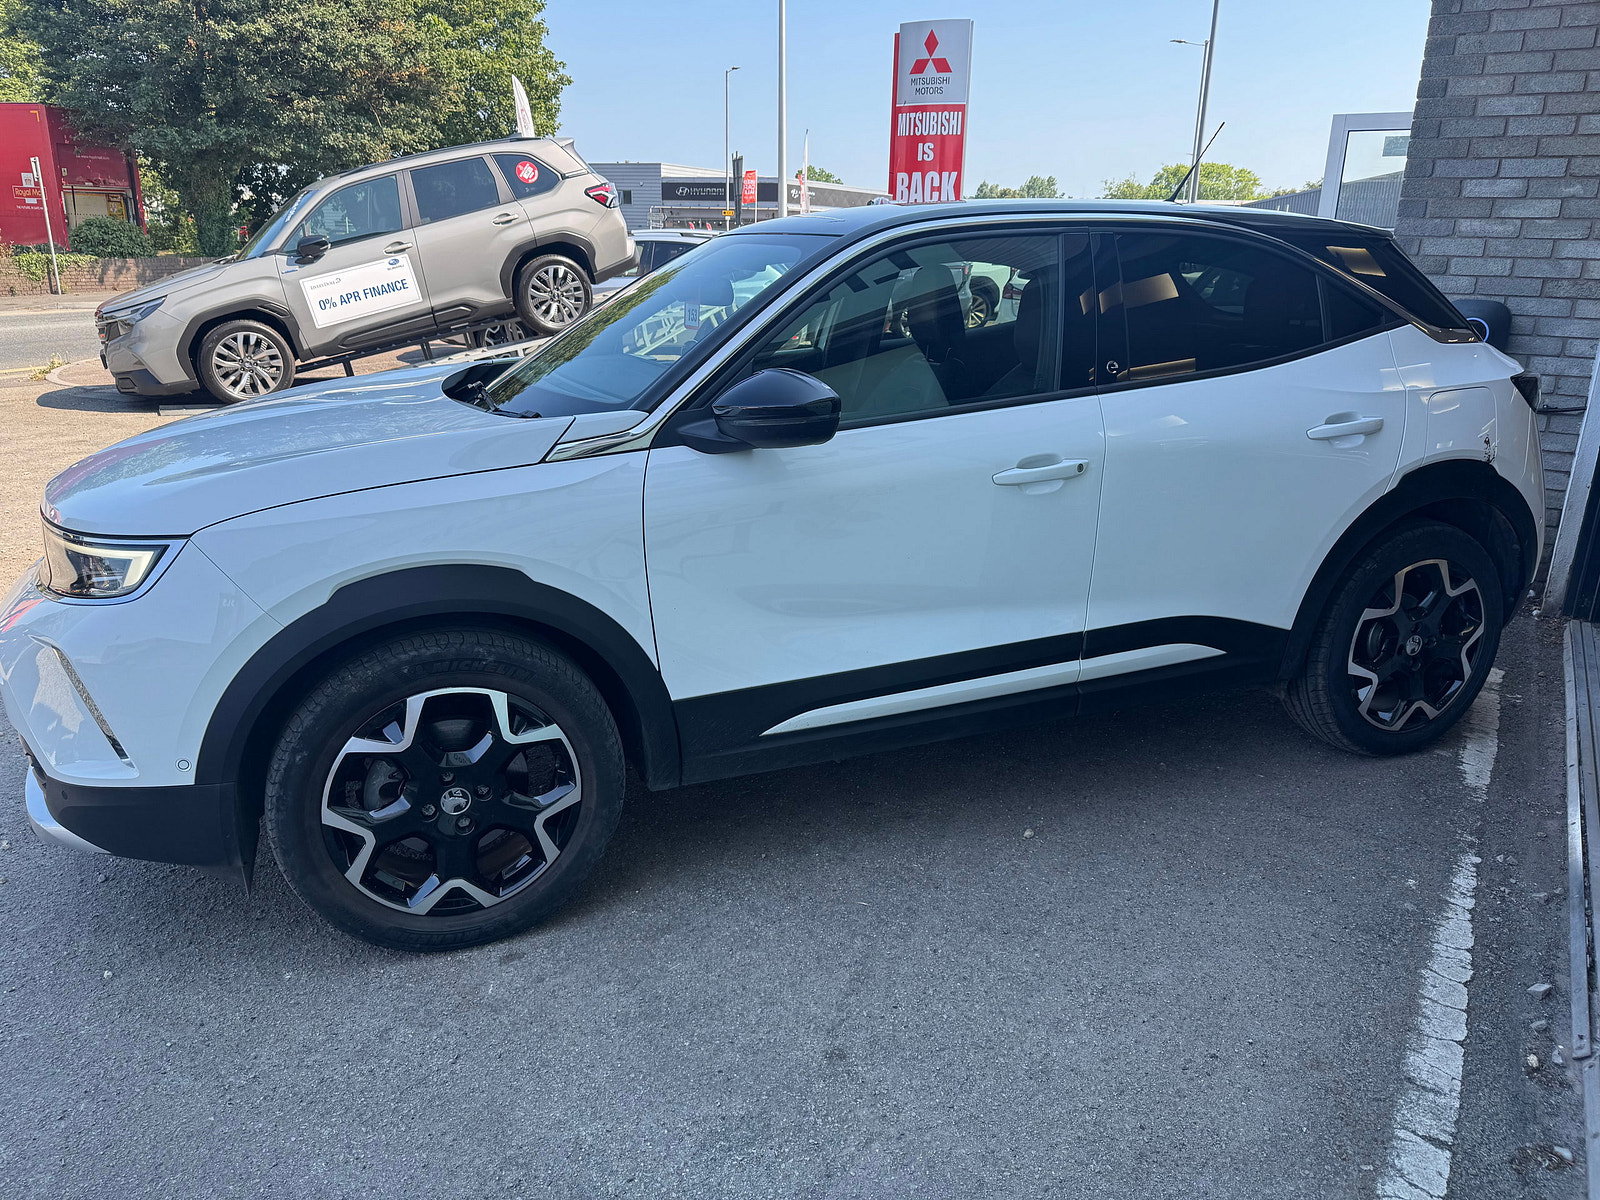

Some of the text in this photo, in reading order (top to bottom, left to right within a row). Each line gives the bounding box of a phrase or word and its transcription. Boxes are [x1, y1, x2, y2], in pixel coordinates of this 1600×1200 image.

[911, 76, 950, 86] MITSUBISHI
[915, 86, 944, 95] MOTORS
[897, 111, 962, 137] MITSUBISHI
[917, 142, 935, 161] IS
[14, 187, 32, 197] Royal
[896, 171, 958, 203] BACK
[318, 278, 409, 311] 0% APR FINANCE
